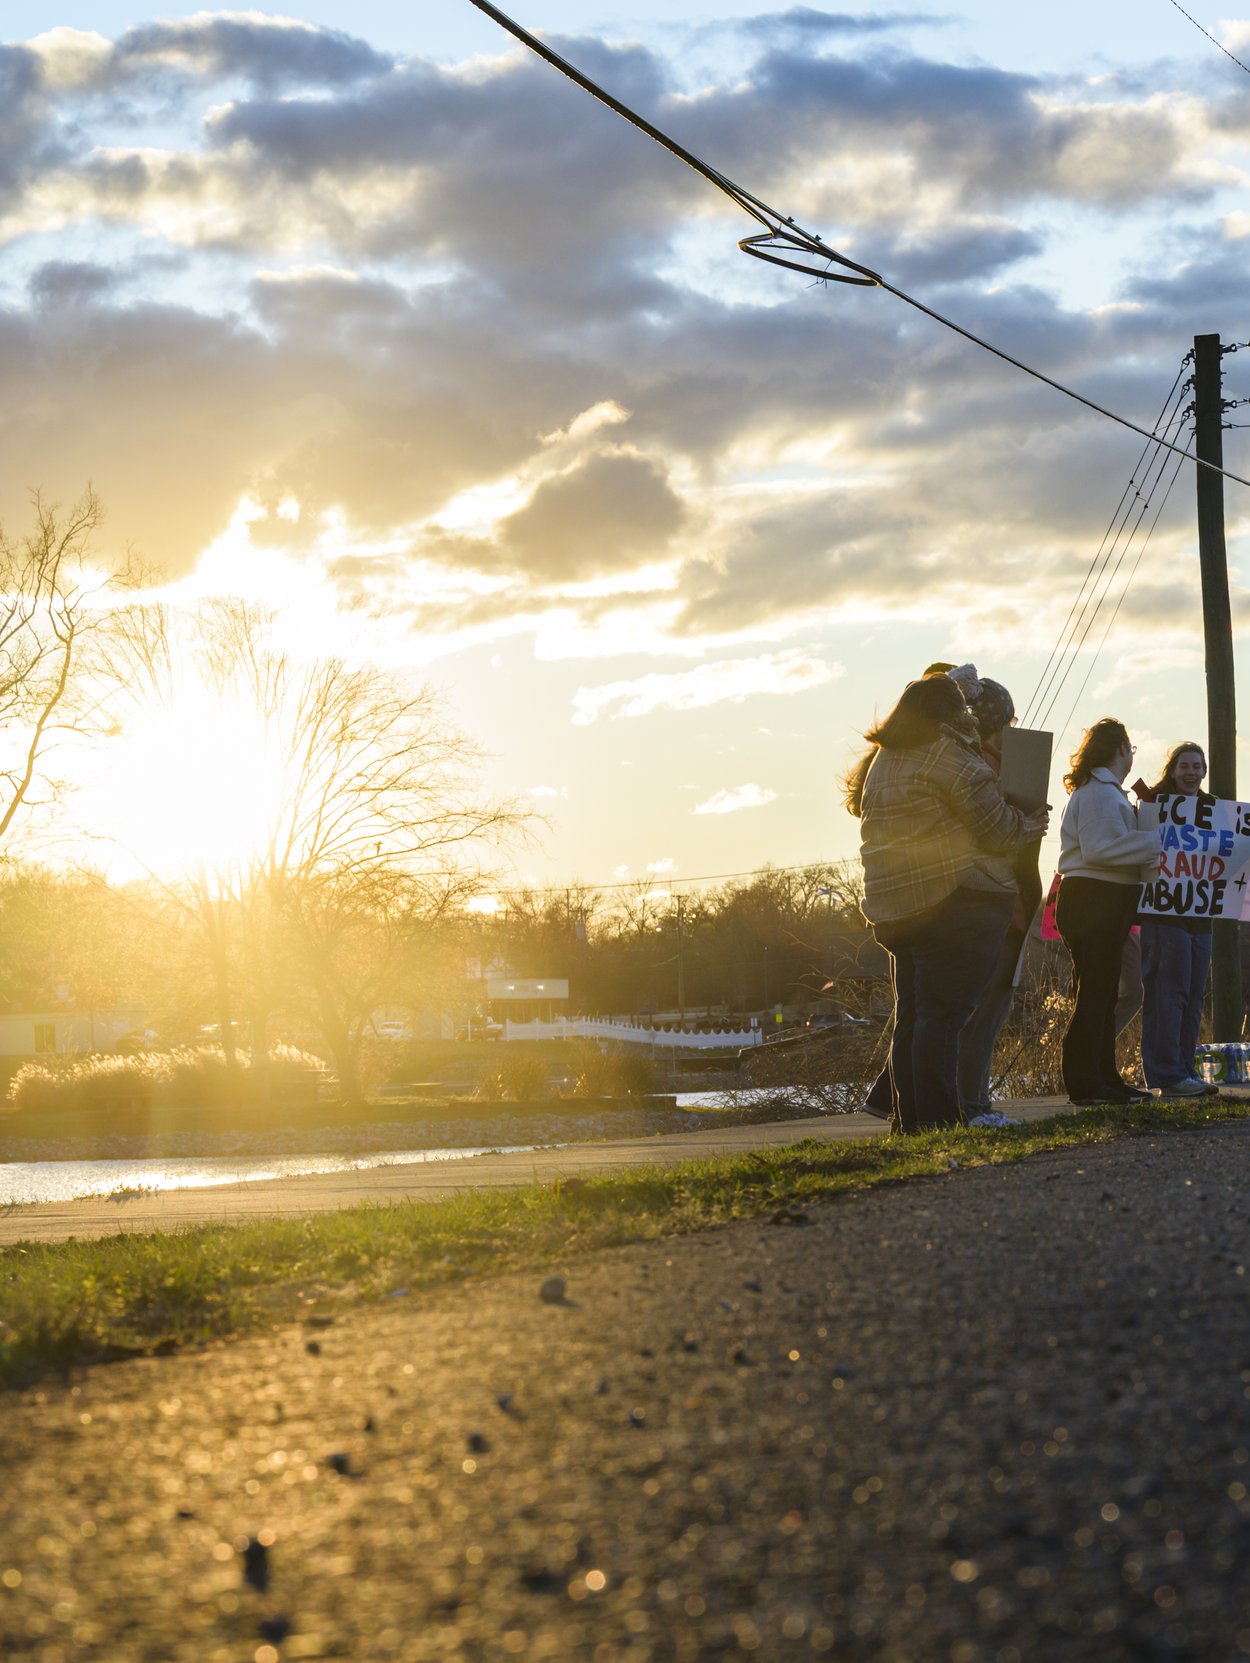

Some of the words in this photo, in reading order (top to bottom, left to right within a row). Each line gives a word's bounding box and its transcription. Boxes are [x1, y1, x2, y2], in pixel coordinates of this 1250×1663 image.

[1158, 793, 1216, 830] ICE
[1159, 850, 1225, 881] RAUD
[1141, 879, 1227, 916] ABUSE
